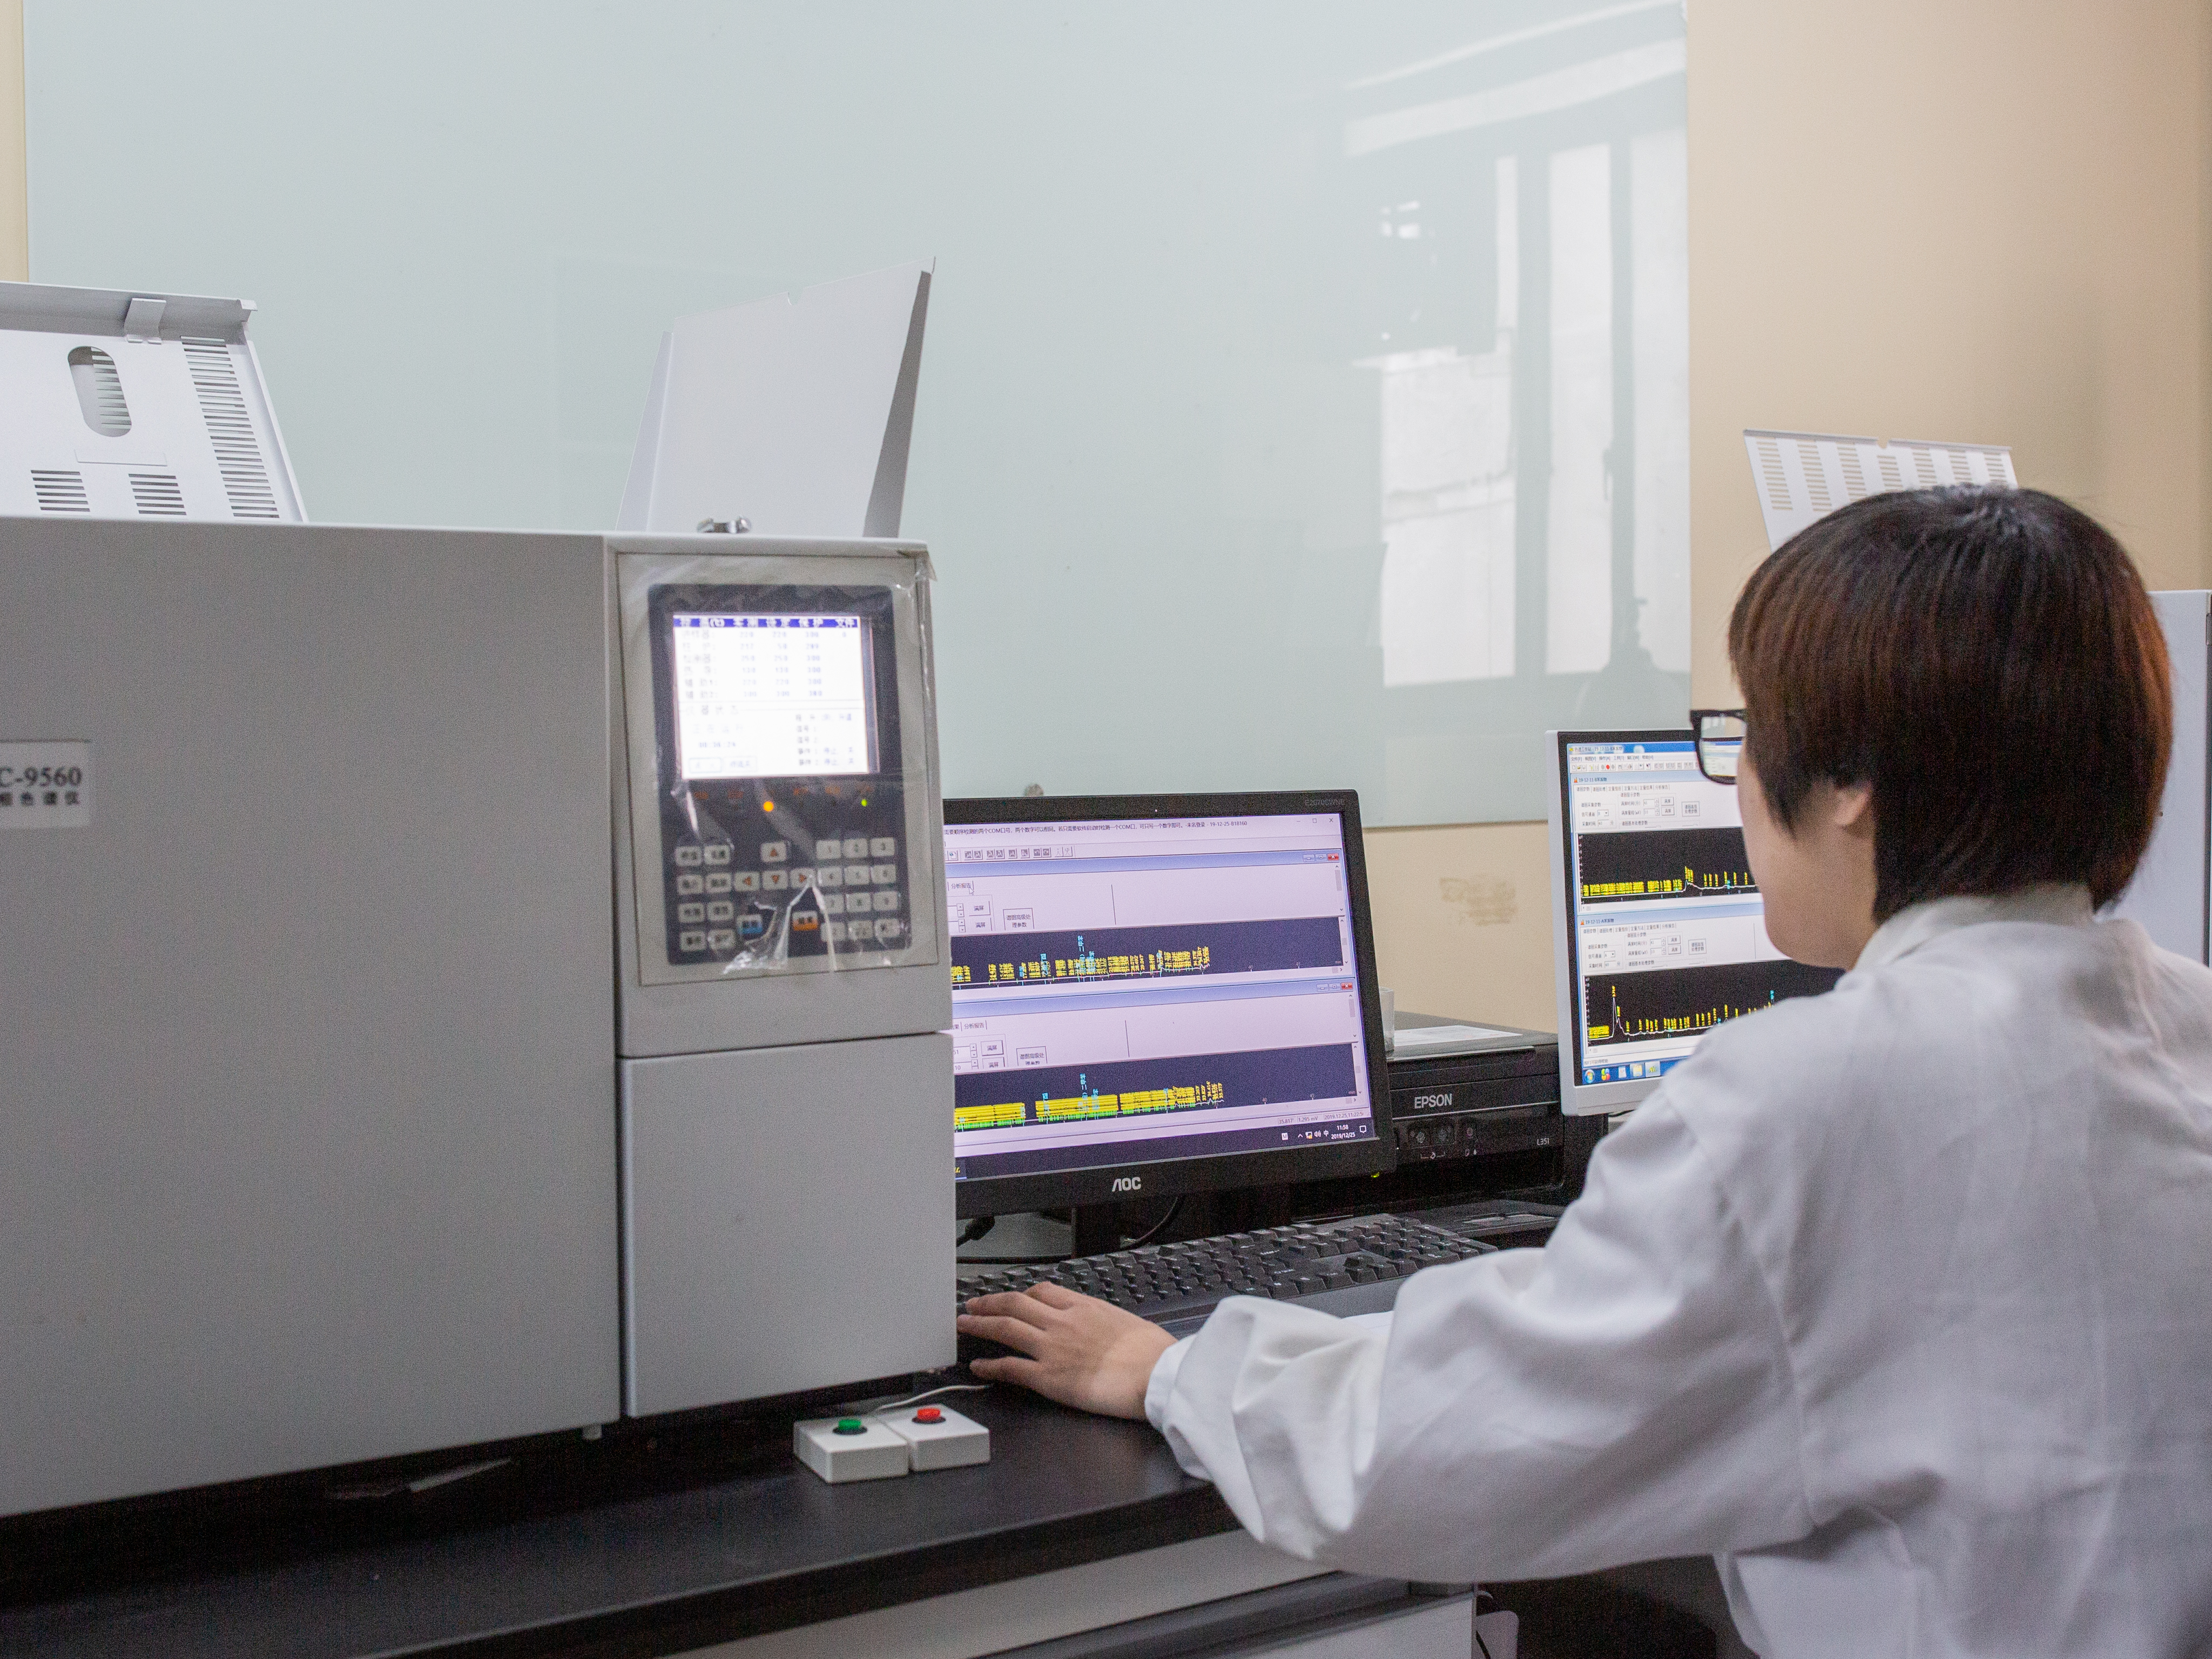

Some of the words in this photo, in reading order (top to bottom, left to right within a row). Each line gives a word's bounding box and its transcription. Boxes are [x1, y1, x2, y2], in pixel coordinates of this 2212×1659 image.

[1414, 1092, 1453, 1109] EPSON
[1331, 1132, 1356, 1140] 2019/12/25
[1111, 1176, 1142, 1192] AOC
